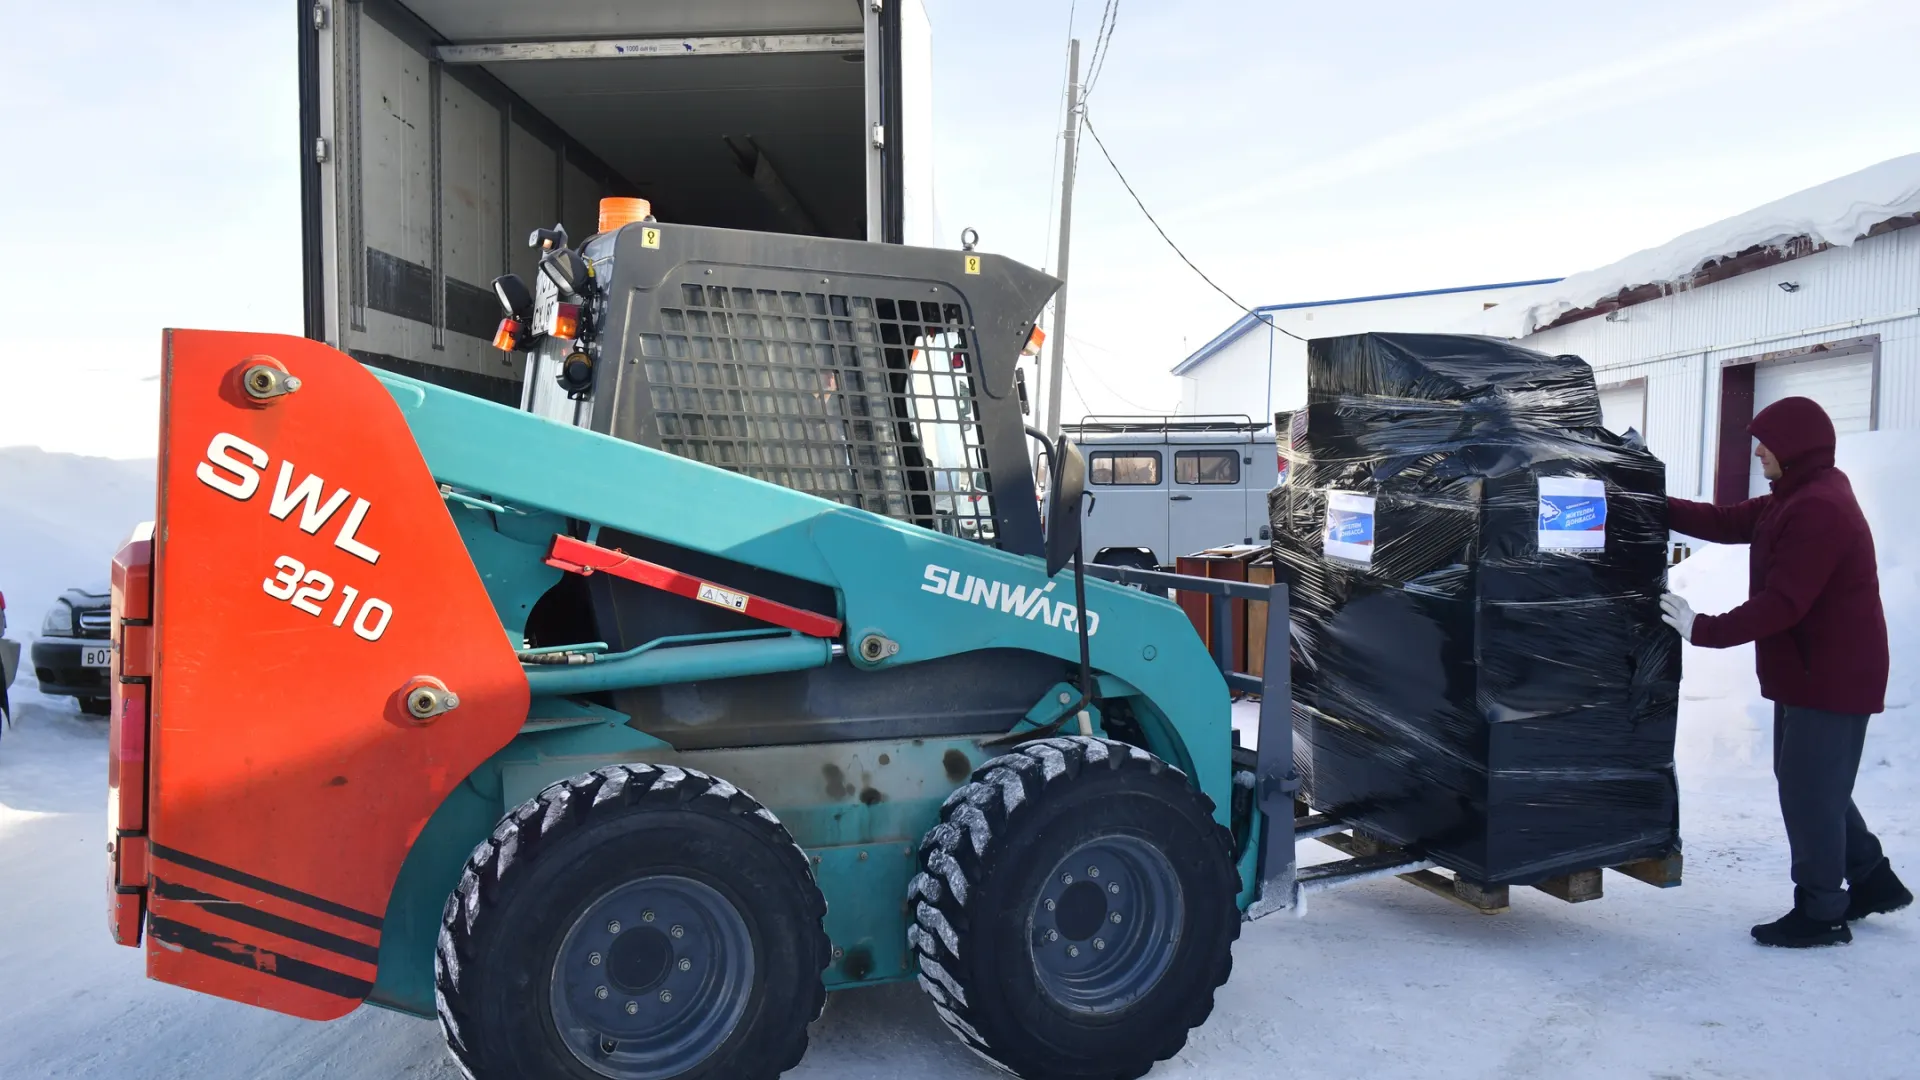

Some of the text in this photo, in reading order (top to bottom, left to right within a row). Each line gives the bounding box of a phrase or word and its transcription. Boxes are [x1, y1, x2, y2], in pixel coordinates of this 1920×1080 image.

[626, 45, 639, 53] 1000
[196, 432, 381, 565] SWL
[262, 555, 393, 642] 3210
[921, 564, 1100, 637] SUNWARD
